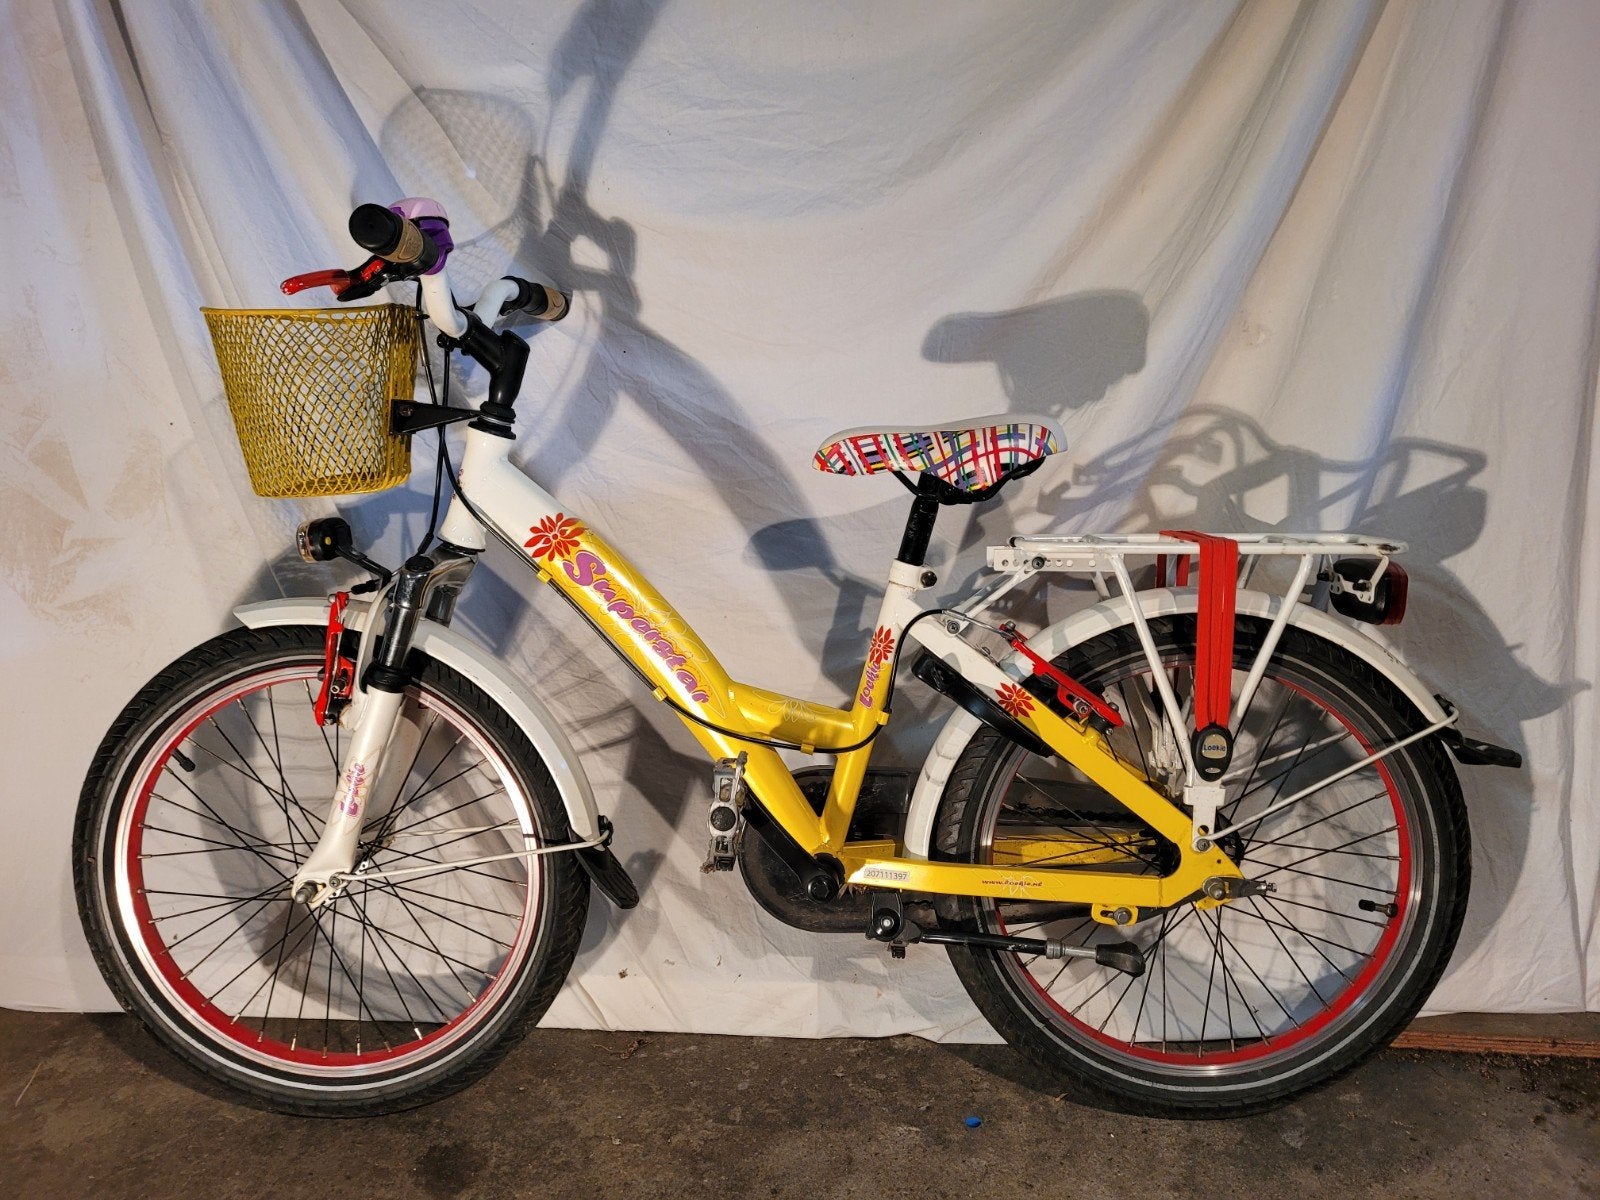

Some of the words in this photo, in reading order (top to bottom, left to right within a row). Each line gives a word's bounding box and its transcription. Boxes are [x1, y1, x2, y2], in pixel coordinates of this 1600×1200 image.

[562, 549, 710, 704] Superstar
[1203, 744, 1226, 752] Loekie
[866, 870, 908, 880] 207111397
